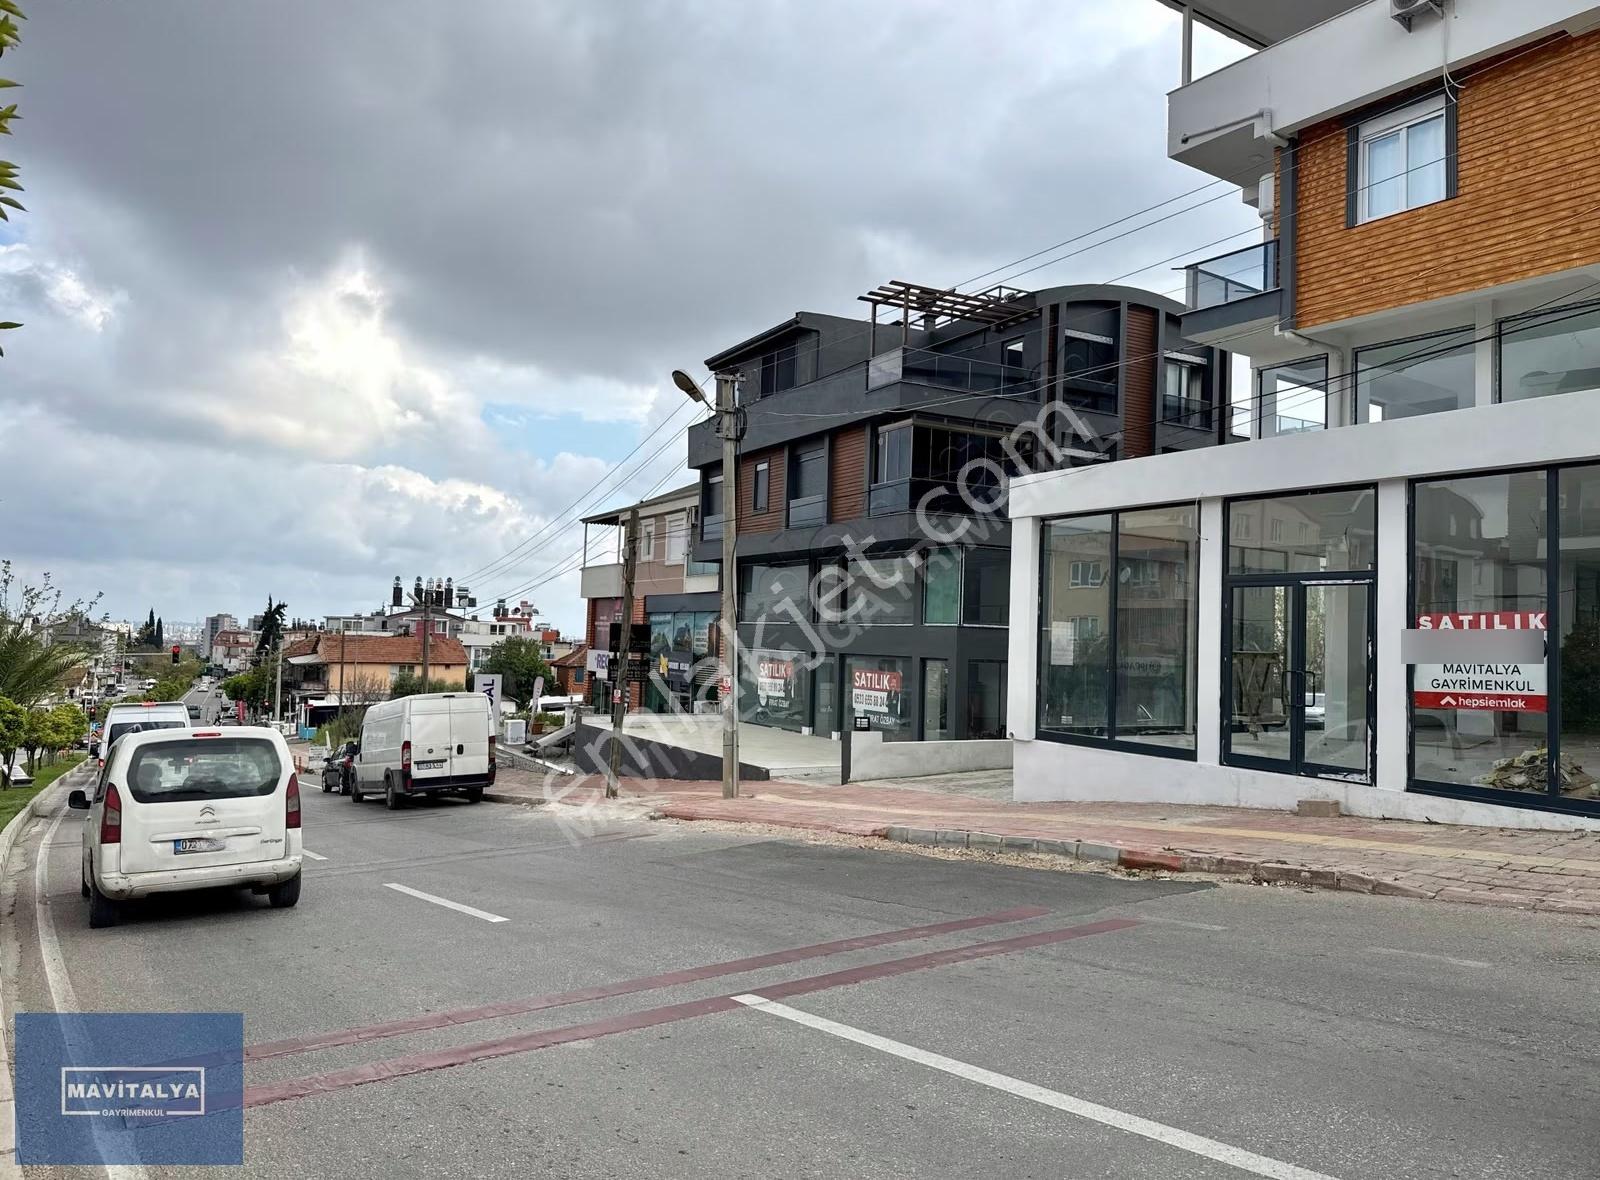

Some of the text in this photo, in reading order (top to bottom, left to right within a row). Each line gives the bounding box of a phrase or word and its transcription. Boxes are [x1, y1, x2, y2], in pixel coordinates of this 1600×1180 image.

[1418, 613, 1546, 630] SATILIK
[760, 663, 786, 677] SATILIK
[854, 672, 889, 689] SATILIK
[1431, 677, 1535, 691] GAYRİMENKUL
[1458, 696, 1527, 709] hepsiemlak
